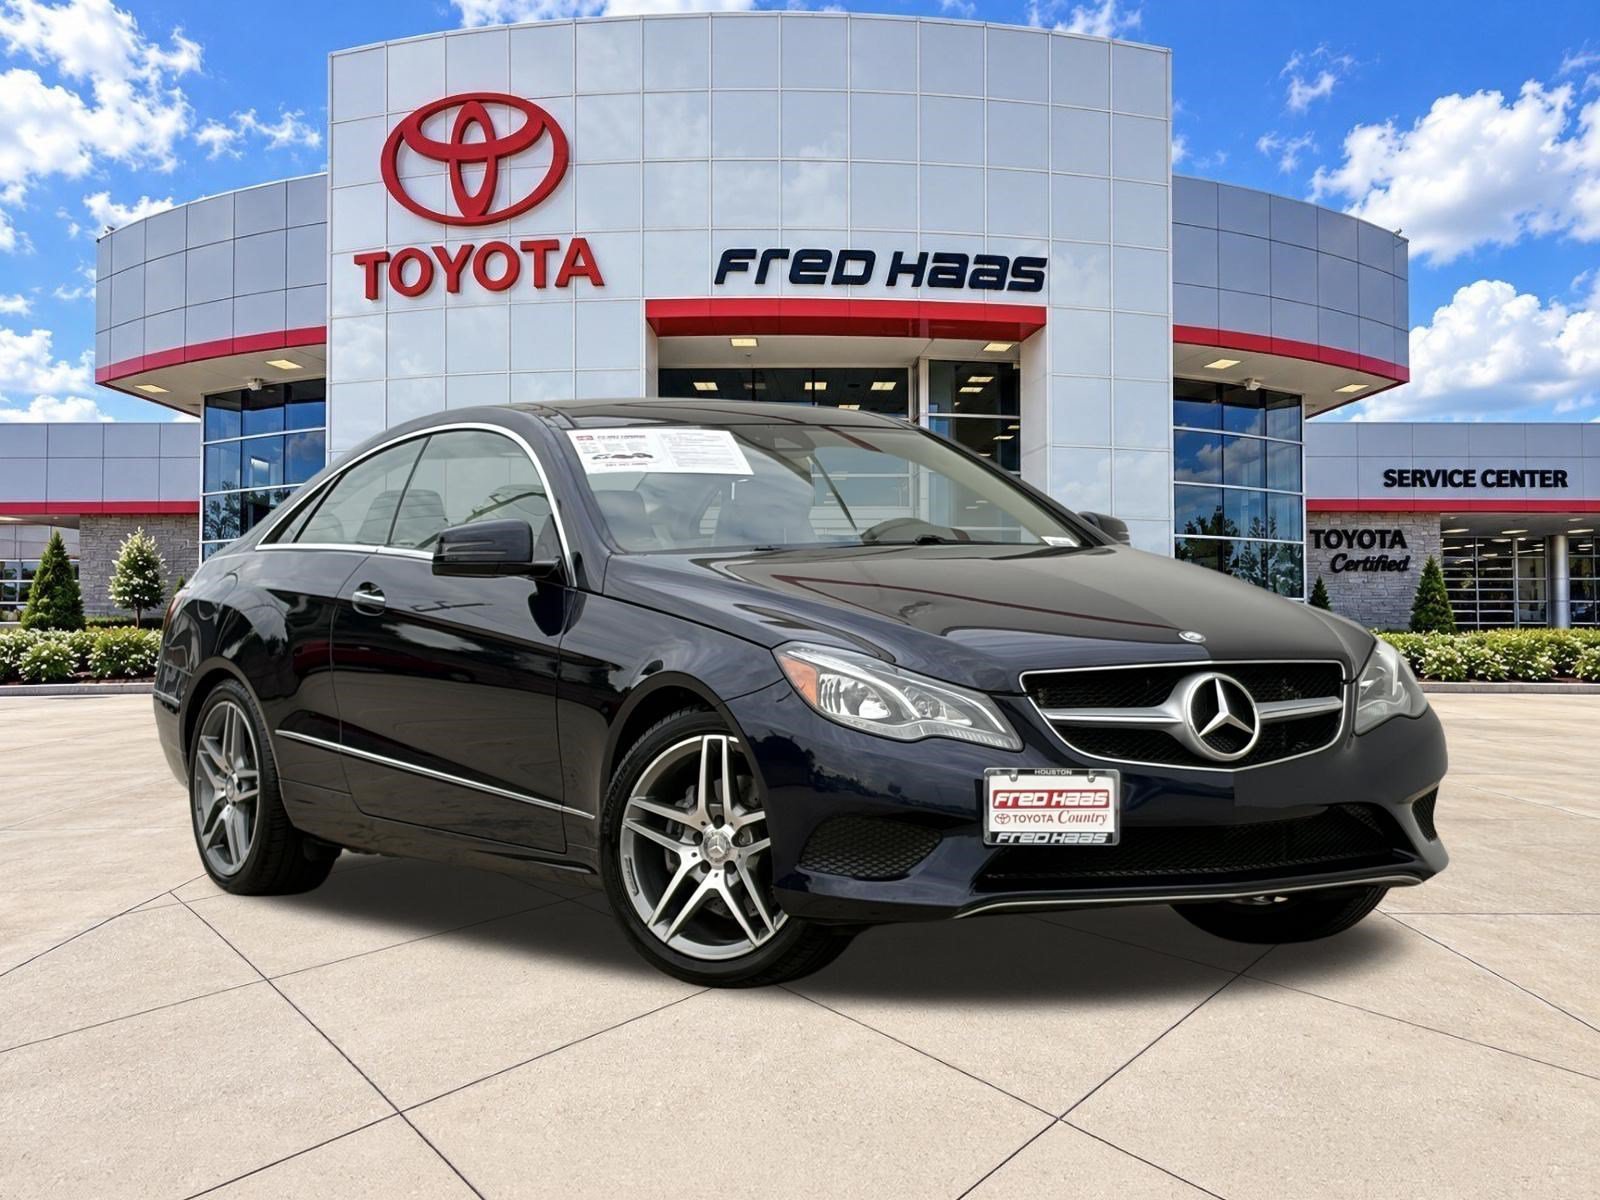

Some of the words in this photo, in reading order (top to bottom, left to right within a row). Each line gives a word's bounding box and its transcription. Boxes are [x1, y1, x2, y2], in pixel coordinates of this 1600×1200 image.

[354, 237, 605, 301] TOYOTA
[1383, 468, 1477, 488] SERVICE
[1480, 469, 1569, 488] CENTER
[1309, 529, 1408, 549] TOYOTA
[1330, 553, 1411, 573] Certified
[1013, 814, 1054, 823] TOYOTA
[1058, 809, 1108, 826] Country
